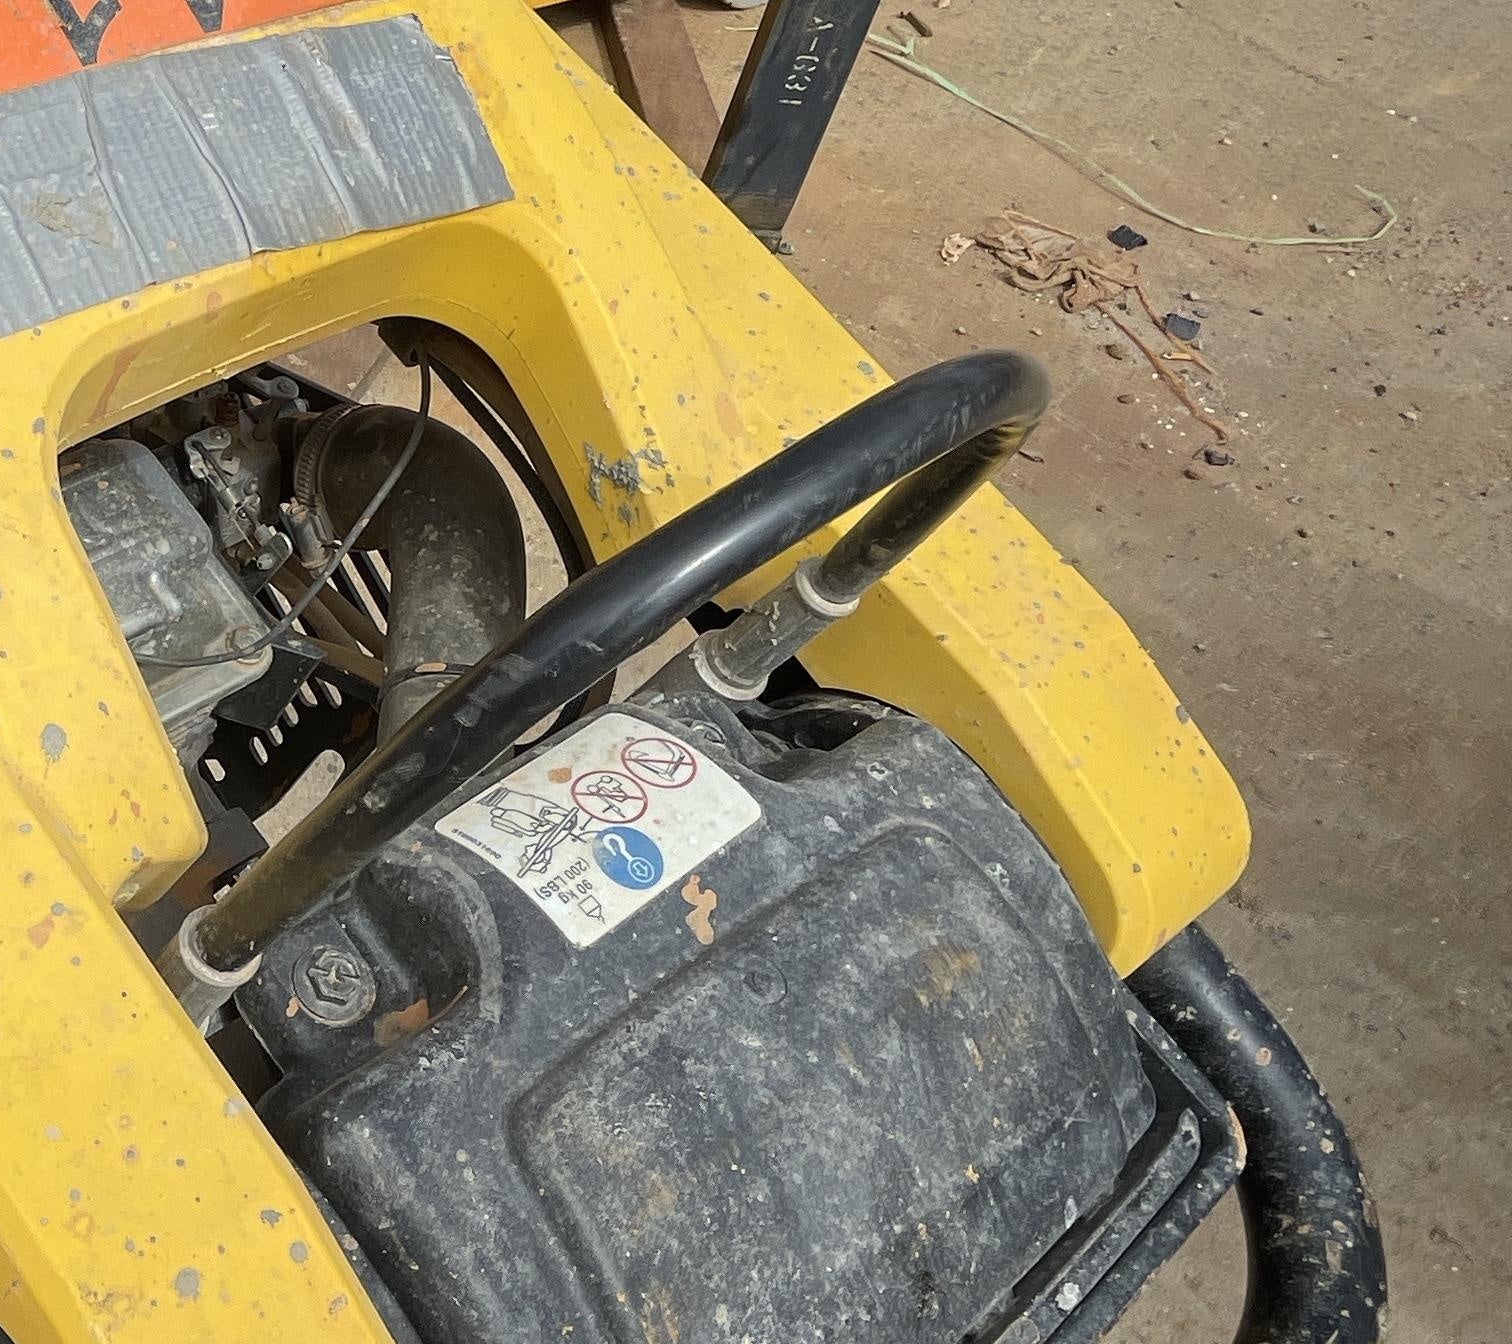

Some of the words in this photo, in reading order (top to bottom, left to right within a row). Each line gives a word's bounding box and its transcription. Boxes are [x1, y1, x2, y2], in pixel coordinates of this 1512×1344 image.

[564, 856, 592, 882] (200
[533, 874, 568, 902] LBS)
[557, 888, 579, 905] kg
[576, 879, 594, 896] 90
